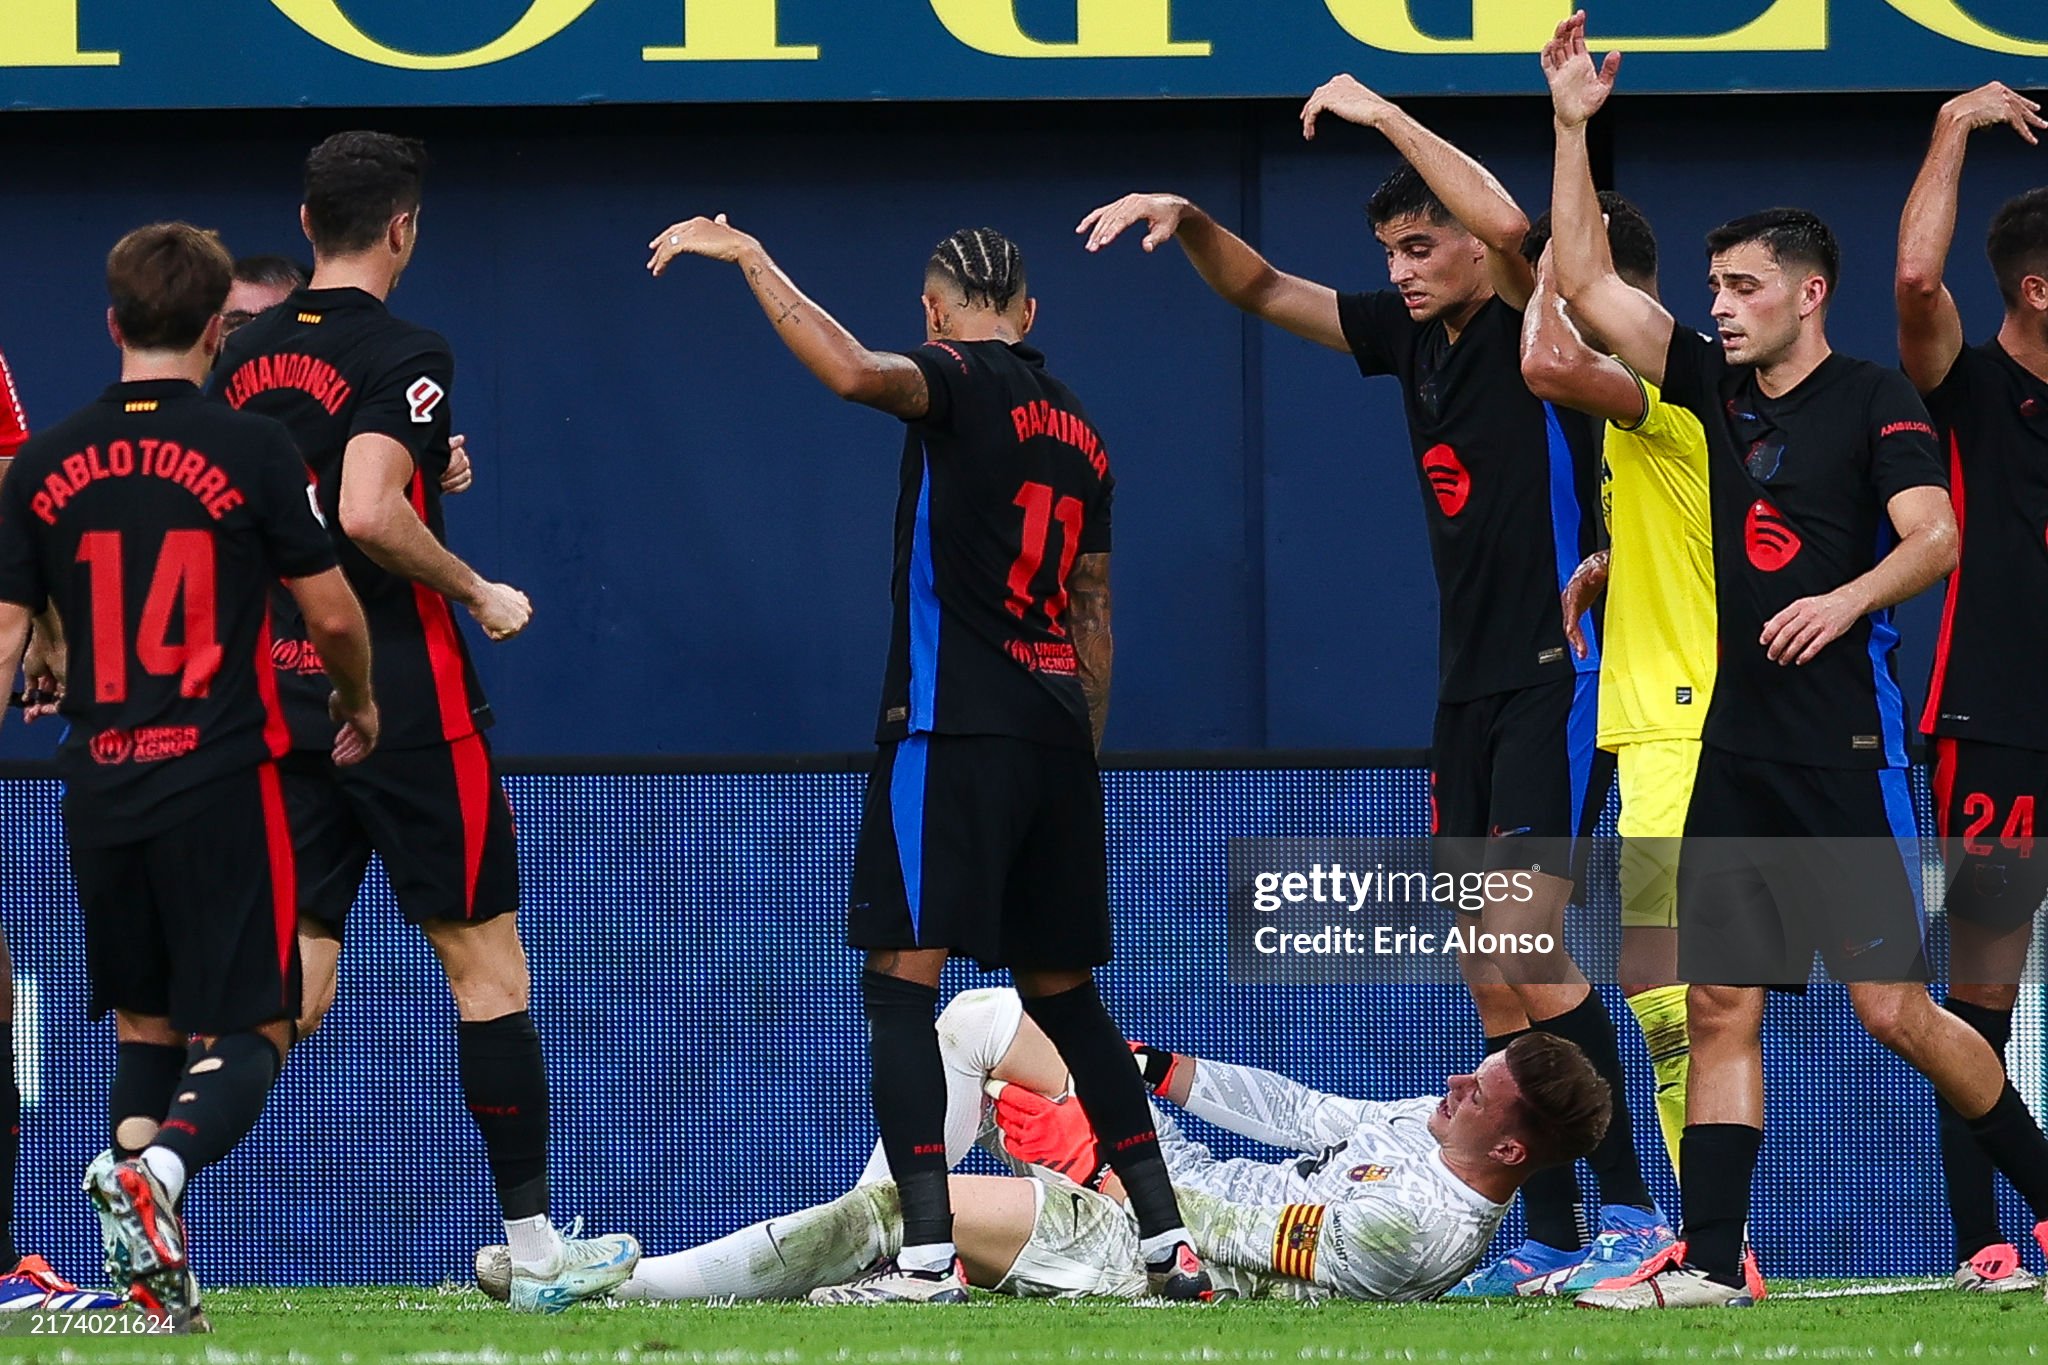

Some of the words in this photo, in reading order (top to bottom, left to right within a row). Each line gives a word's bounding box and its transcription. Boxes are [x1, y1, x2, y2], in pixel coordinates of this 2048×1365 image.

[31, 439, 135, 525] PABLO
[139, 438, 245, 519] TORRE
[76, 529, 223, 703] 14
[1005, 481, 1084, 636] 11
[1963, 792, 2035, 858] 24
